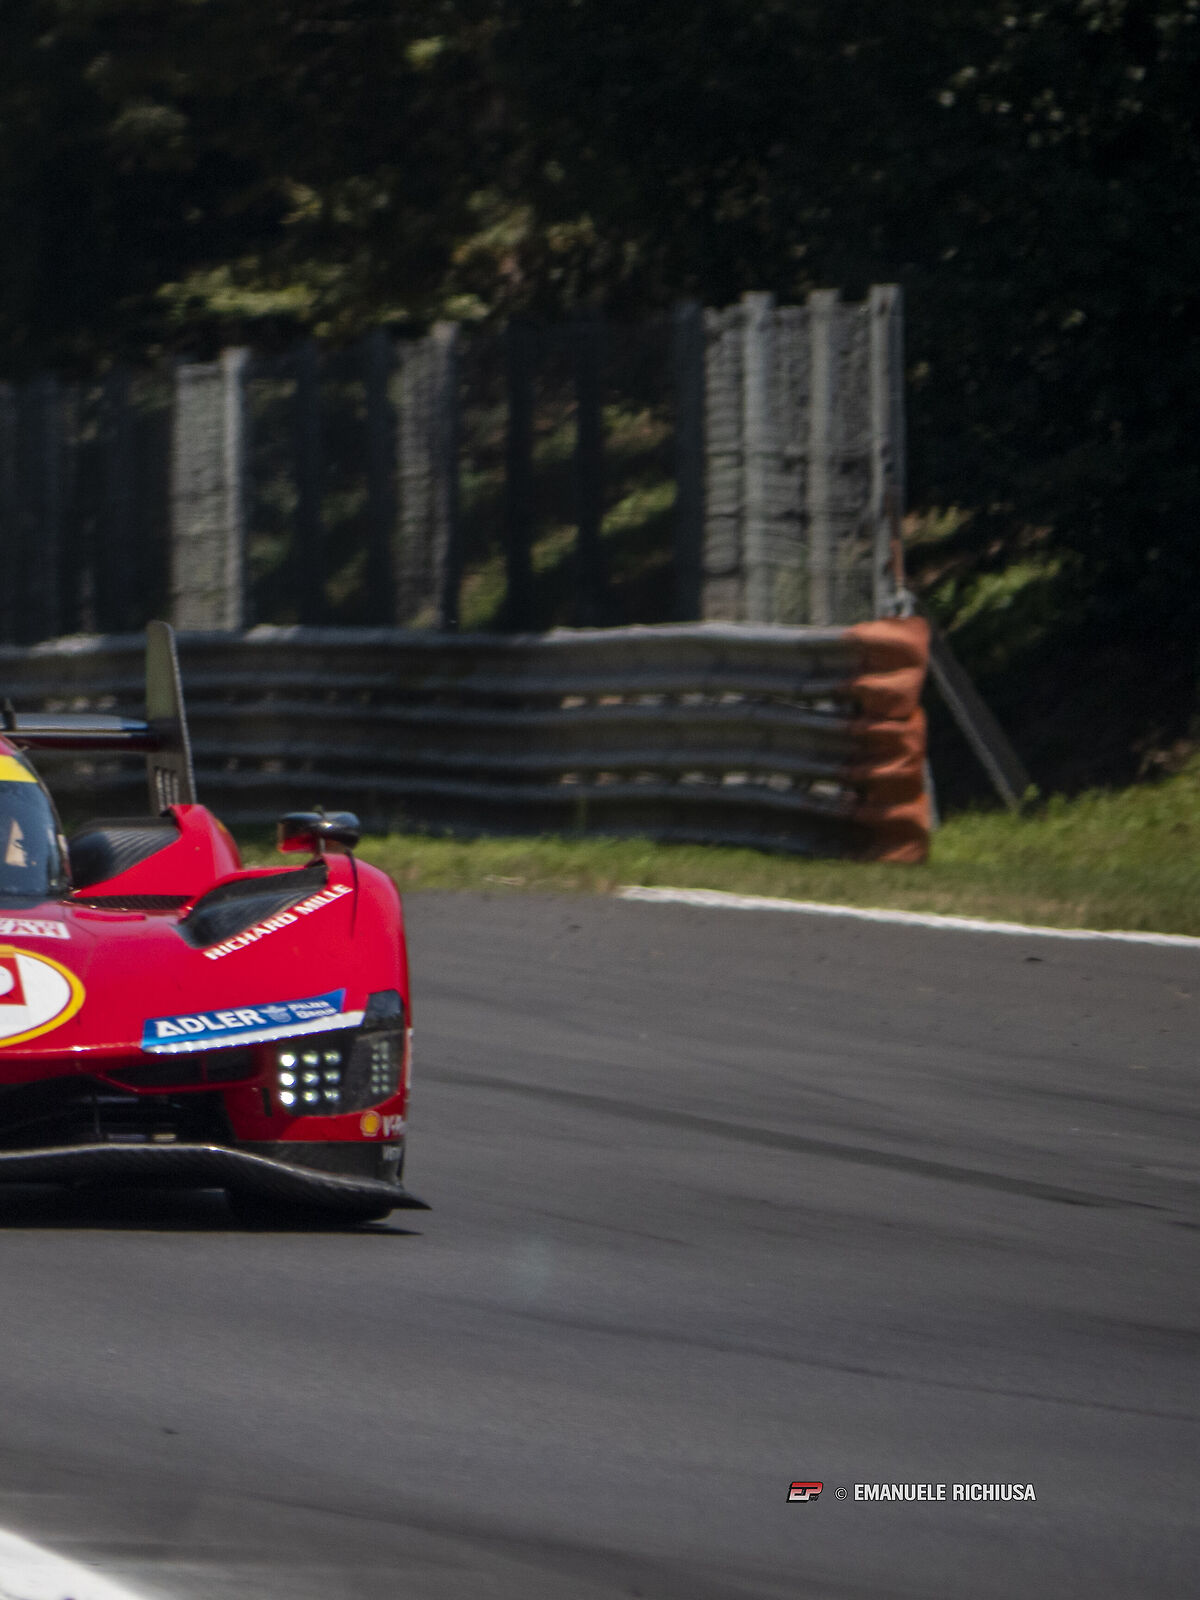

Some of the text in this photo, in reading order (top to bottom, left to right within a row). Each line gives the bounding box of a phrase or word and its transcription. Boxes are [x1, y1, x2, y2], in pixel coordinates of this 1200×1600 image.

[202, 884, 354, 960] RICHARD MILLE
[155, 1008, 267, 1039] ADLER
